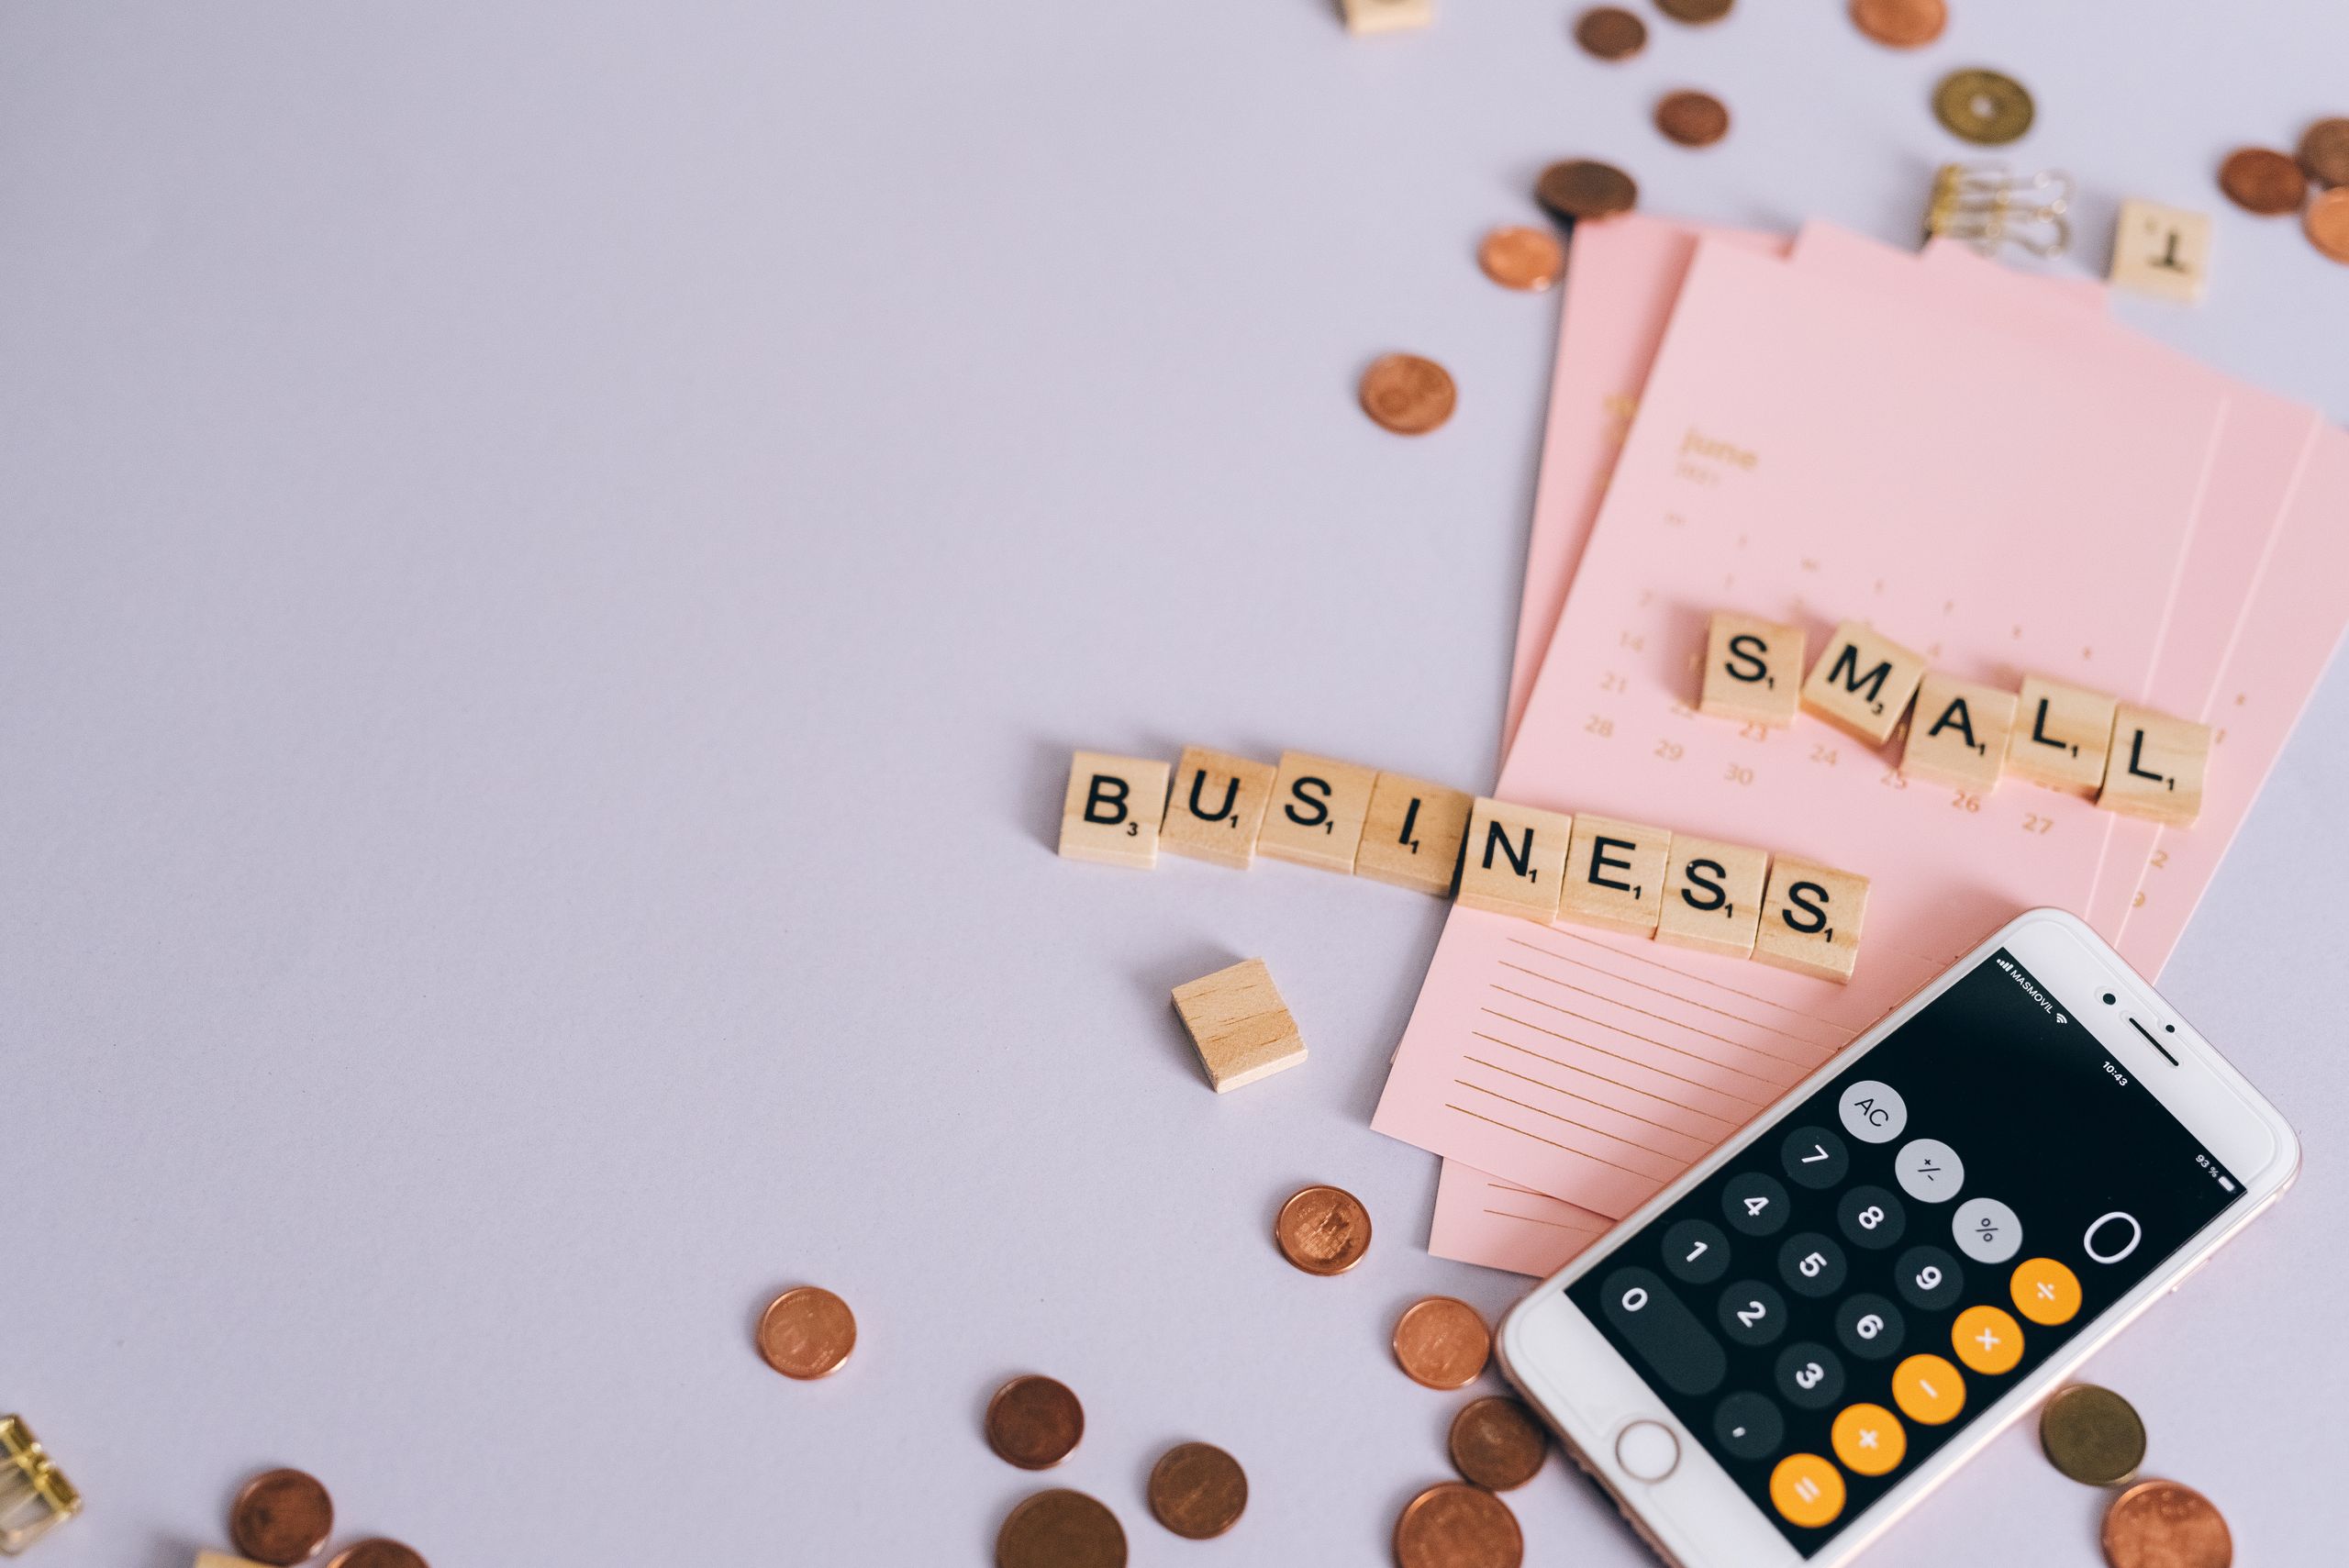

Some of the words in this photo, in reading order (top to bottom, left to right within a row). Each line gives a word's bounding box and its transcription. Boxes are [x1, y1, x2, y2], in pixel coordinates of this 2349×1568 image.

[1725, 635, 2164, 782] SMALL
[1584, 714, 1615, 740] 28
[1654, 738, 1685, 762] 29
[1725, 762, 1754, 786] 30
[1952, 788, 1981, 813] 26
[2022, 812, 2054, 835] 27
[1084, 770, 1831, 934] BUSINESS
[2009, 970, 2054, 1014] MASMOVIL
[2103, 1062, 2128, 1086] 10:43
[1854, 1098, 1889, 1128] AC
[1976, 1218, 1999, 1242] %
[2196, 1154, 2210, 1168] 93
[1802, 1144, 1829, 1163] 7
[1859, 1207, 1885, 1230] 8
[1916, 1266, 1943, 1290] 9
[2084, 1212, 2142, 1264] 0
[1621, 1287, 1648, 1312] 0
[1744, 1197, 1770, 1217] 4
[1799, 1252, 1827, 1277] 5
[1857, 1315, 1884, 1340] 6
[1687, 1240, 1708, 1262] 1
[1737, 1301, 1766, 1328] 2
[1796, 1362, 1824, 1389] 3
